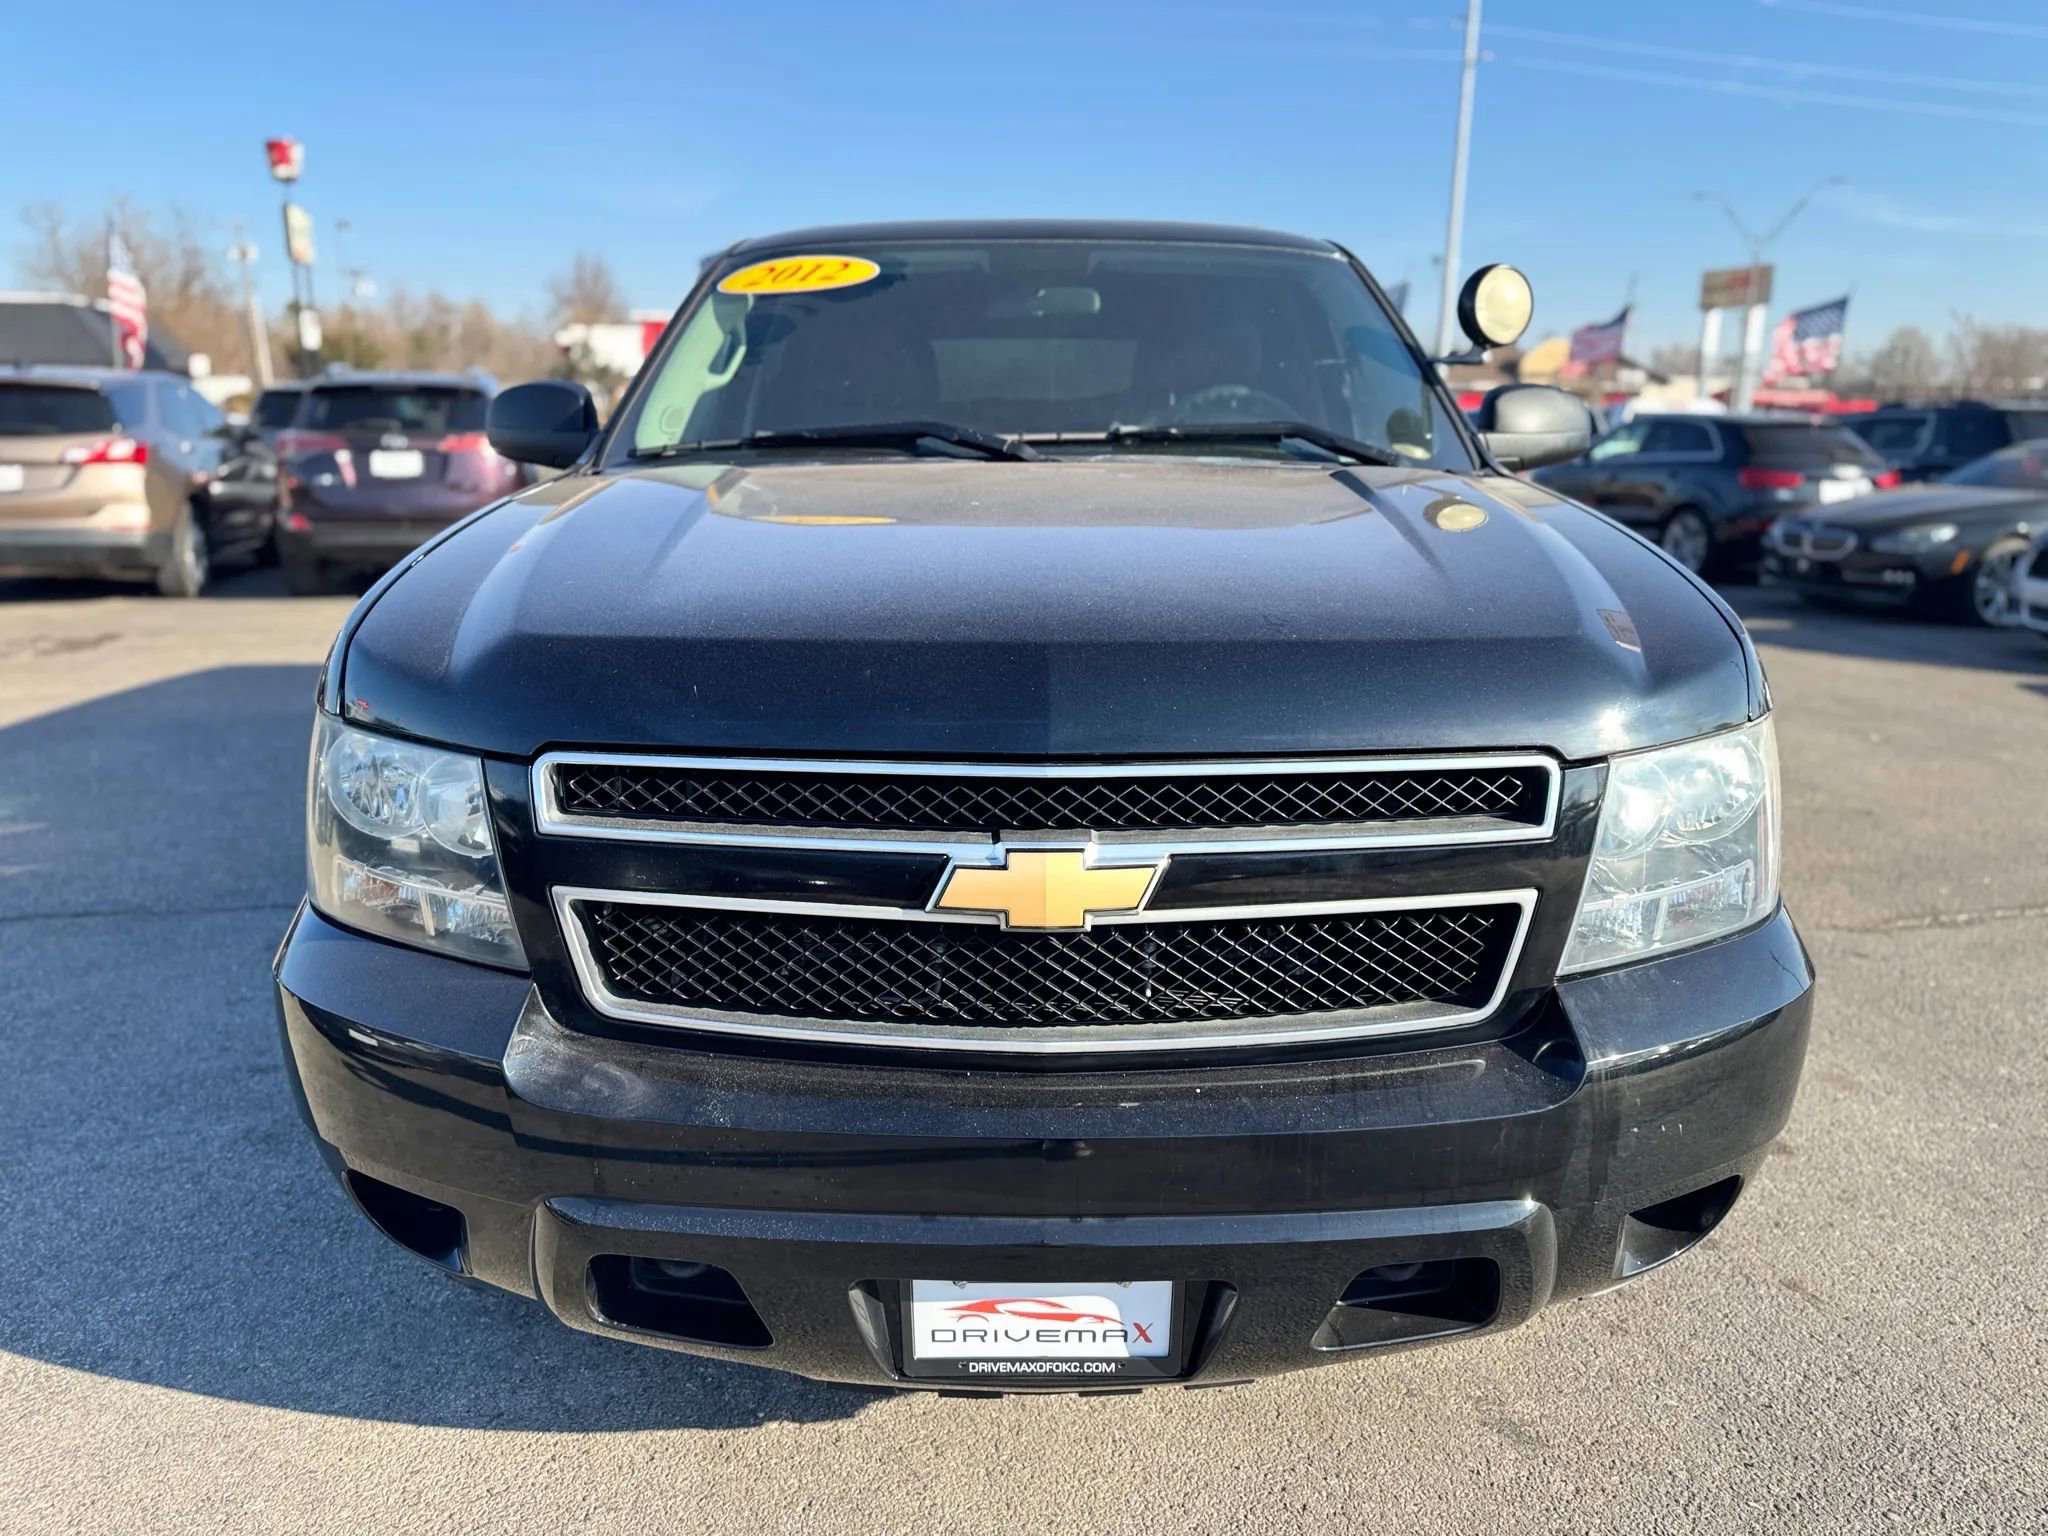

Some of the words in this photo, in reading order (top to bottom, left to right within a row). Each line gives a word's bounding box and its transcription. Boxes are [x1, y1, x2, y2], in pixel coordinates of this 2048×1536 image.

[743, 262, 850, 287] 2012
[931, 1322, 1154, 1344] DRIVEMAX
[968, 1361, 1116, 1374] DRIVEMAXOFOKC.COM
